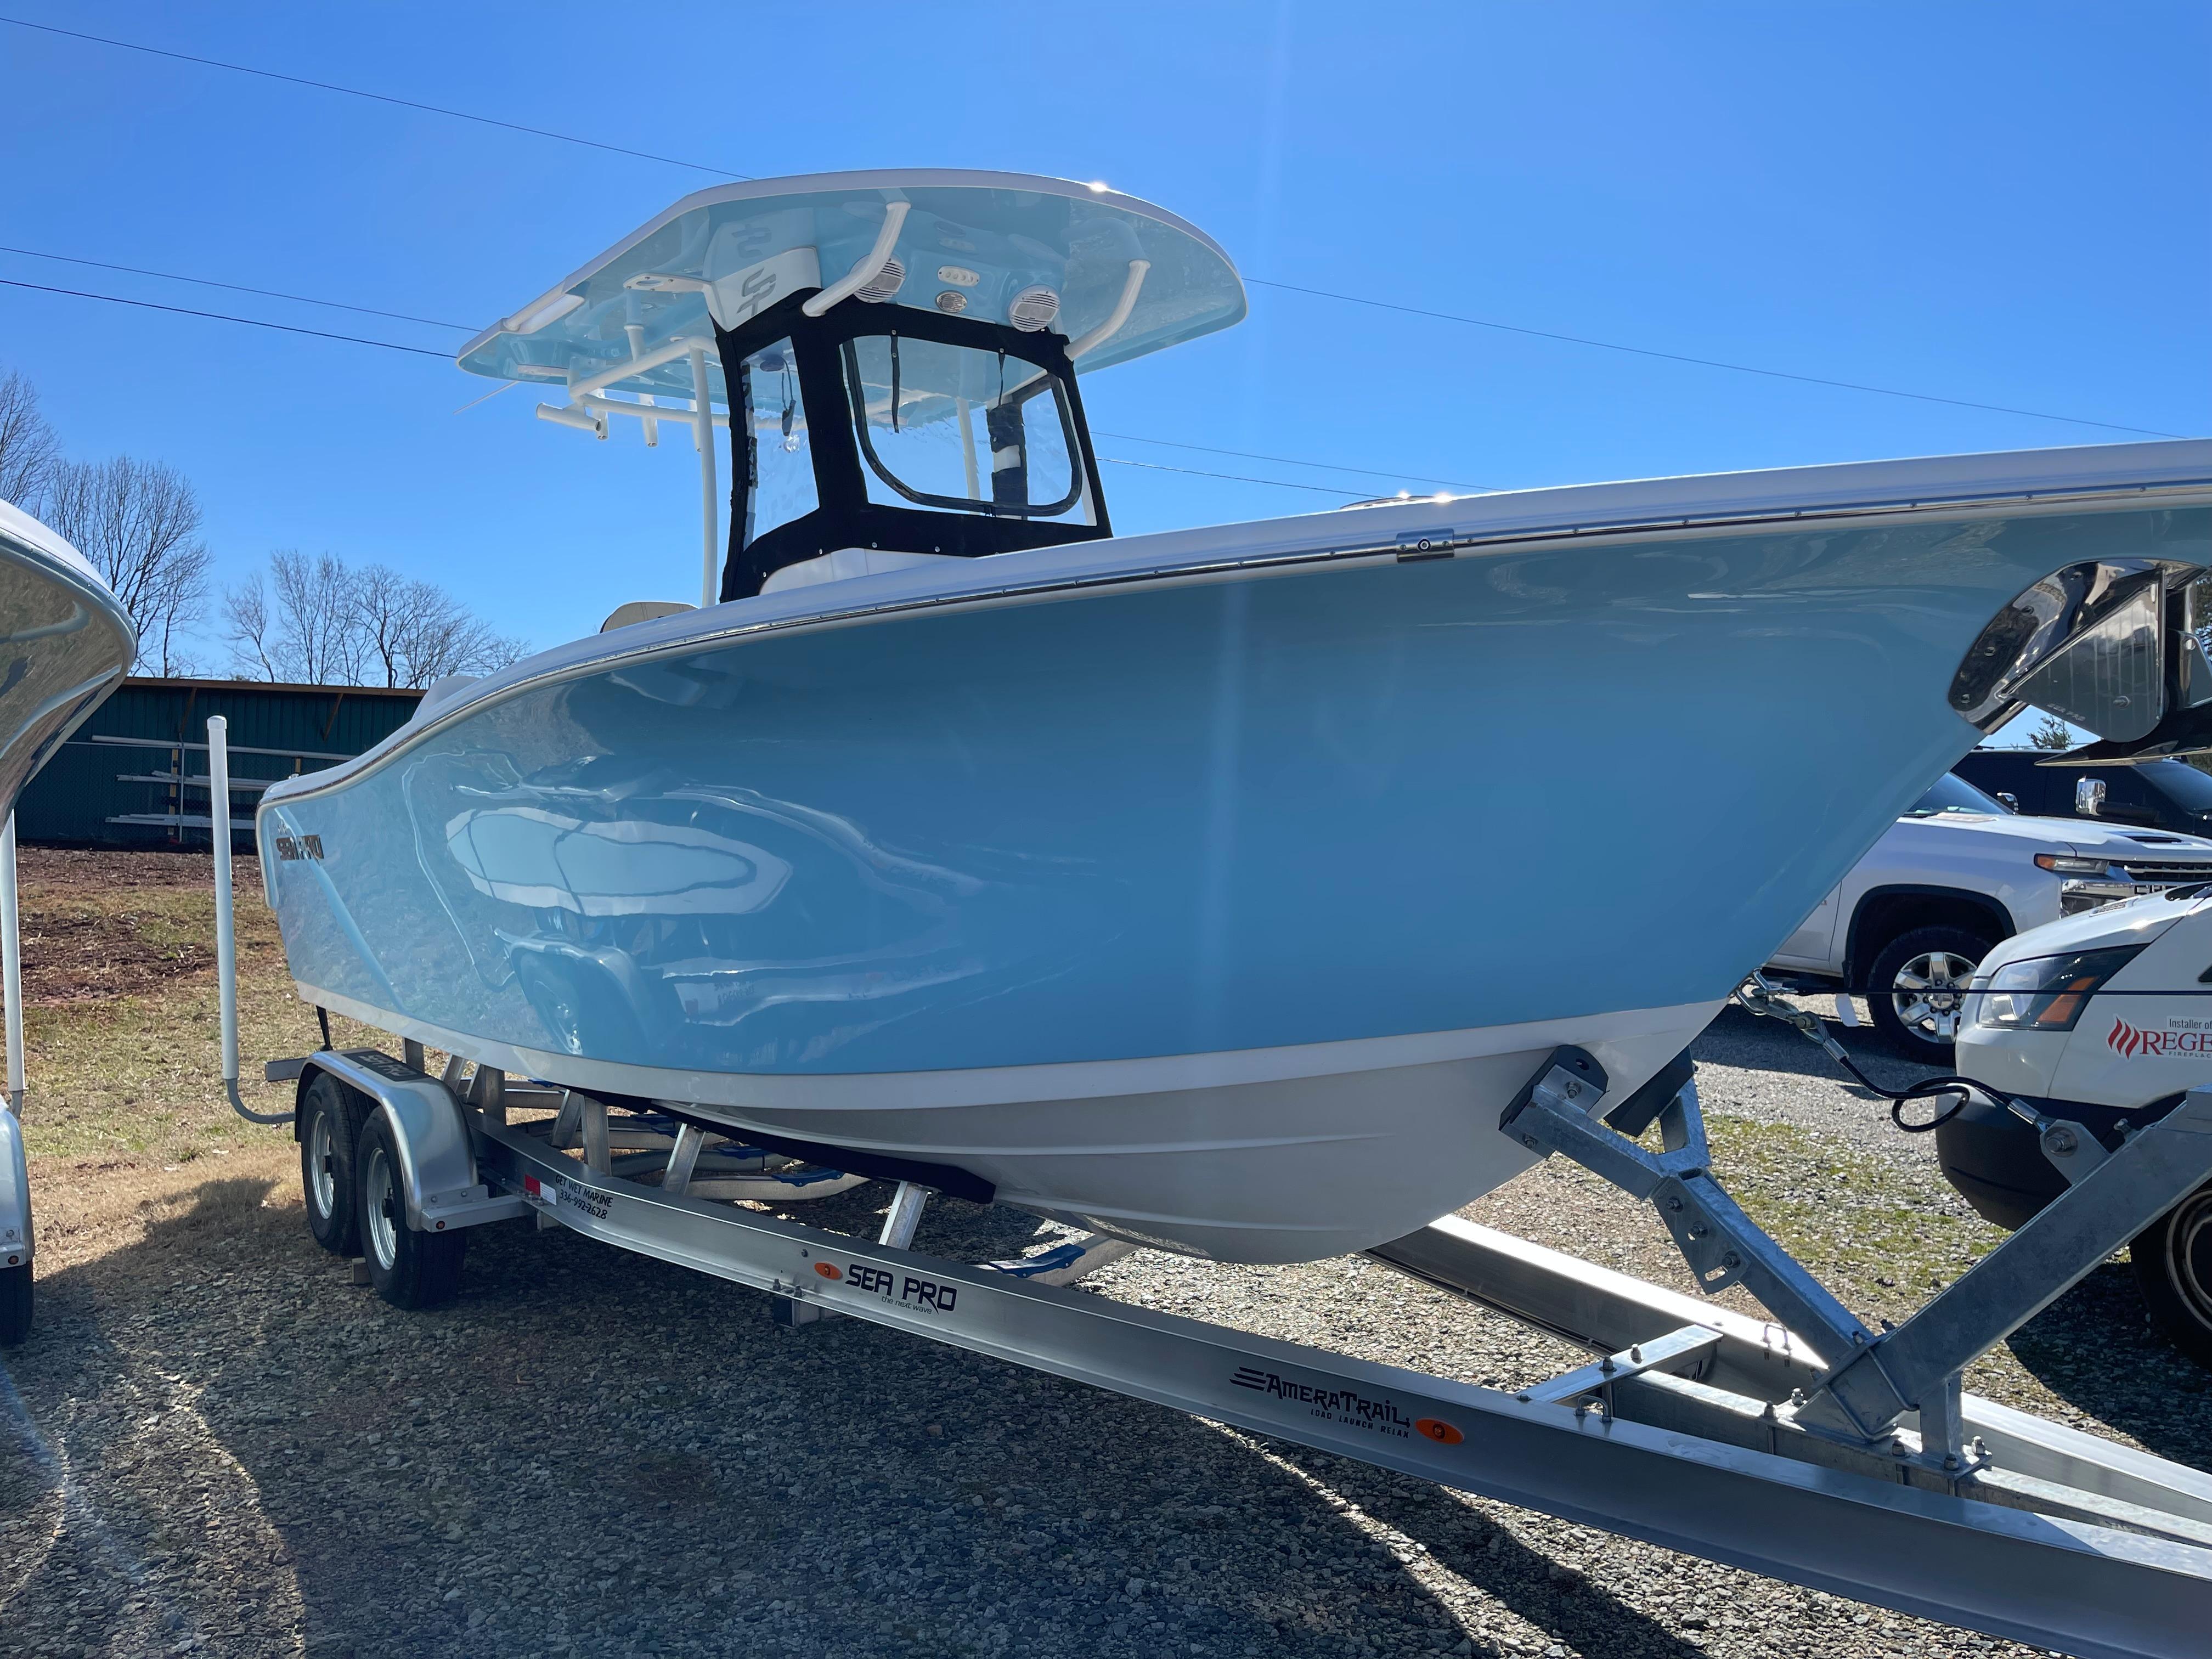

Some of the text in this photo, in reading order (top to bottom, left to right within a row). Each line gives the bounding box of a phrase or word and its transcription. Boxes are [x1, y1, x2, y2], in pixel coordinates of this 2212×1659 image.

[2169, 1018, 2202, 1029] Installer
[555, 1174, 567, 1187] GET
[568, 1180, 583, 1195] WET
[583, 1188, 613, 1207] MARINE
[560, 1189, 608, 1220] 336-992-2628
[845, 1263, 957, 1316] SEA PRO
[881, 1295, 932, 1314] the next wave
[1311, 1408, 1409, 1439] LOAD LAUNCH RELAX
